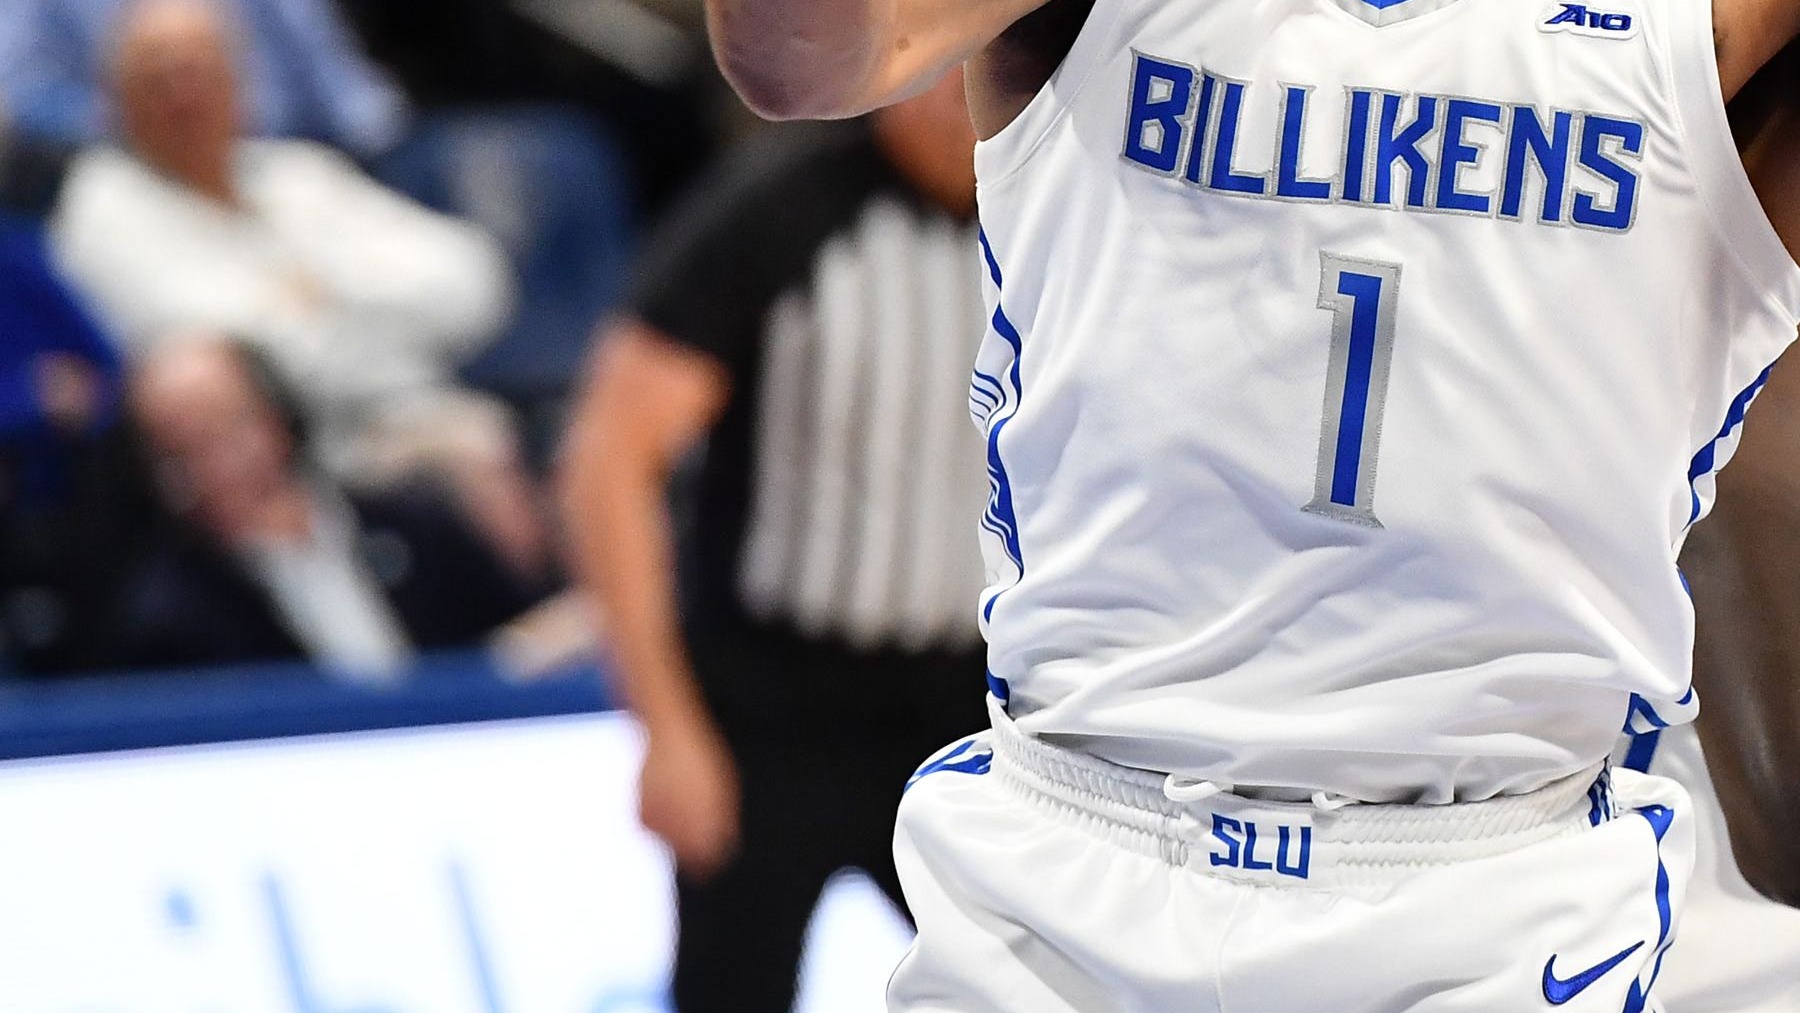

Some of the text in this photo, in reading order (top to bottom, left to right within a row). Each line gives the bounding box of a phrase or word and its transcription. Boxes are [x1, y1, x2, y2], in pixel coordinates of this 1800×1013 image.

[1544, 3, 1632, 31] A10
[1119, 47, 1648, 234] BILLIKENS
[1301, 251, 1402, 529] 1
[1209, 813, 1311, 879] SLU
